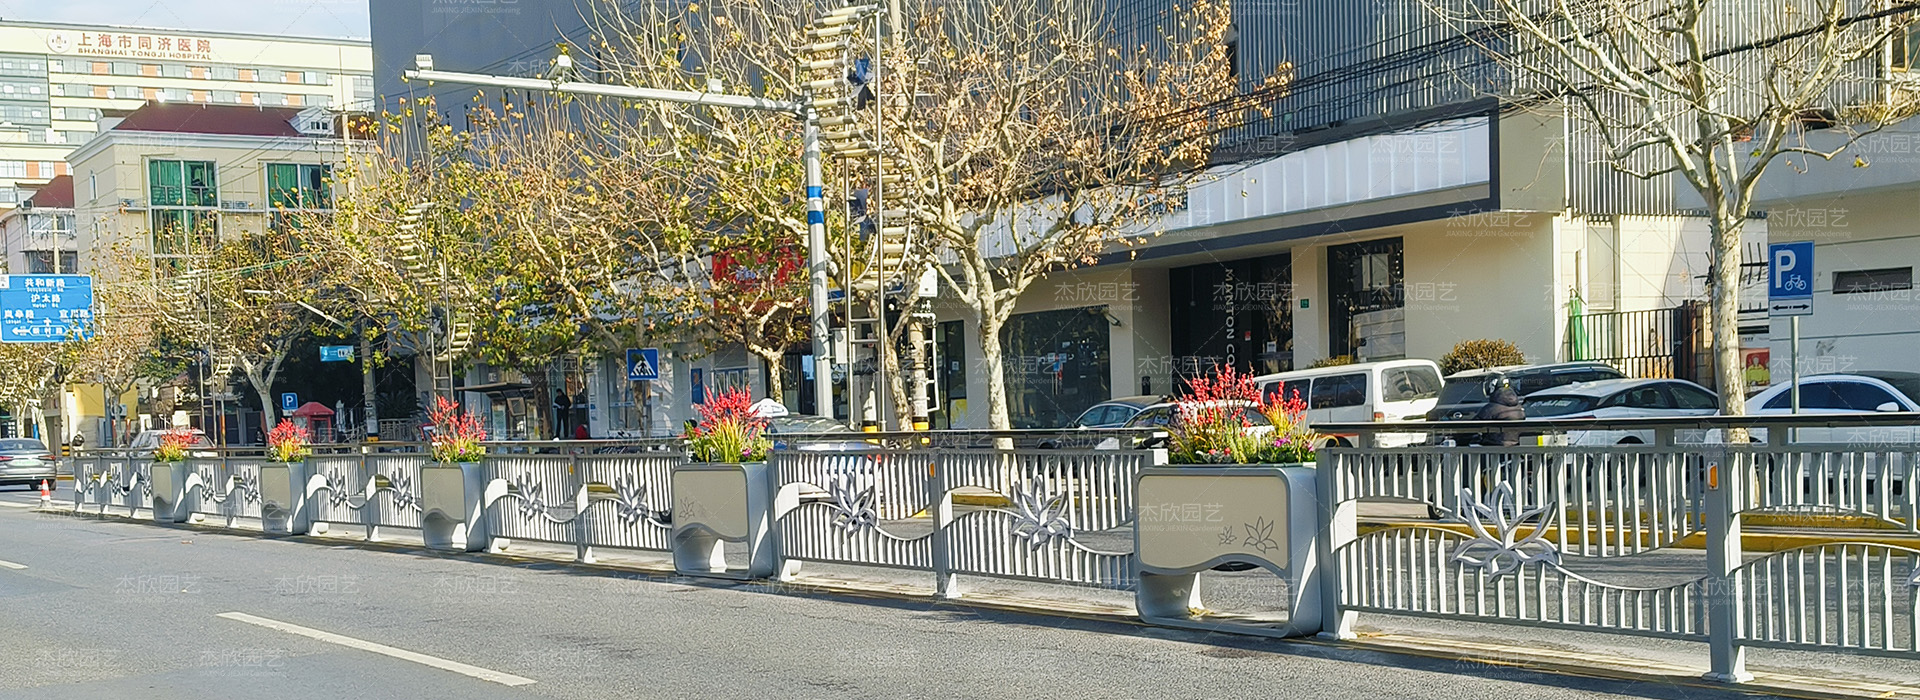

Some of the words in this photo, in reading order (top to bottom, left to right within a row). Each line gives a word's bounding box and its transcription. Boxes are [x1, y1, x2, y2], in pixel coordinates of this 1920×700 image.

[78, 32, 211, 53] 上海市同济医院
[78, 48, 127, 56] SHANGHAI
[131, 50, 166, 58] TONGJI
[169, 52, 212, 60] HOSPITAL
[1775, 249, 1796, 288] P
[25, 278, 65, 287] 共和新路
[31, 294, 61, 303] 沪太路
[1225, 268, 1235, 340] MANTON
[286, 395, 294, 406] P
